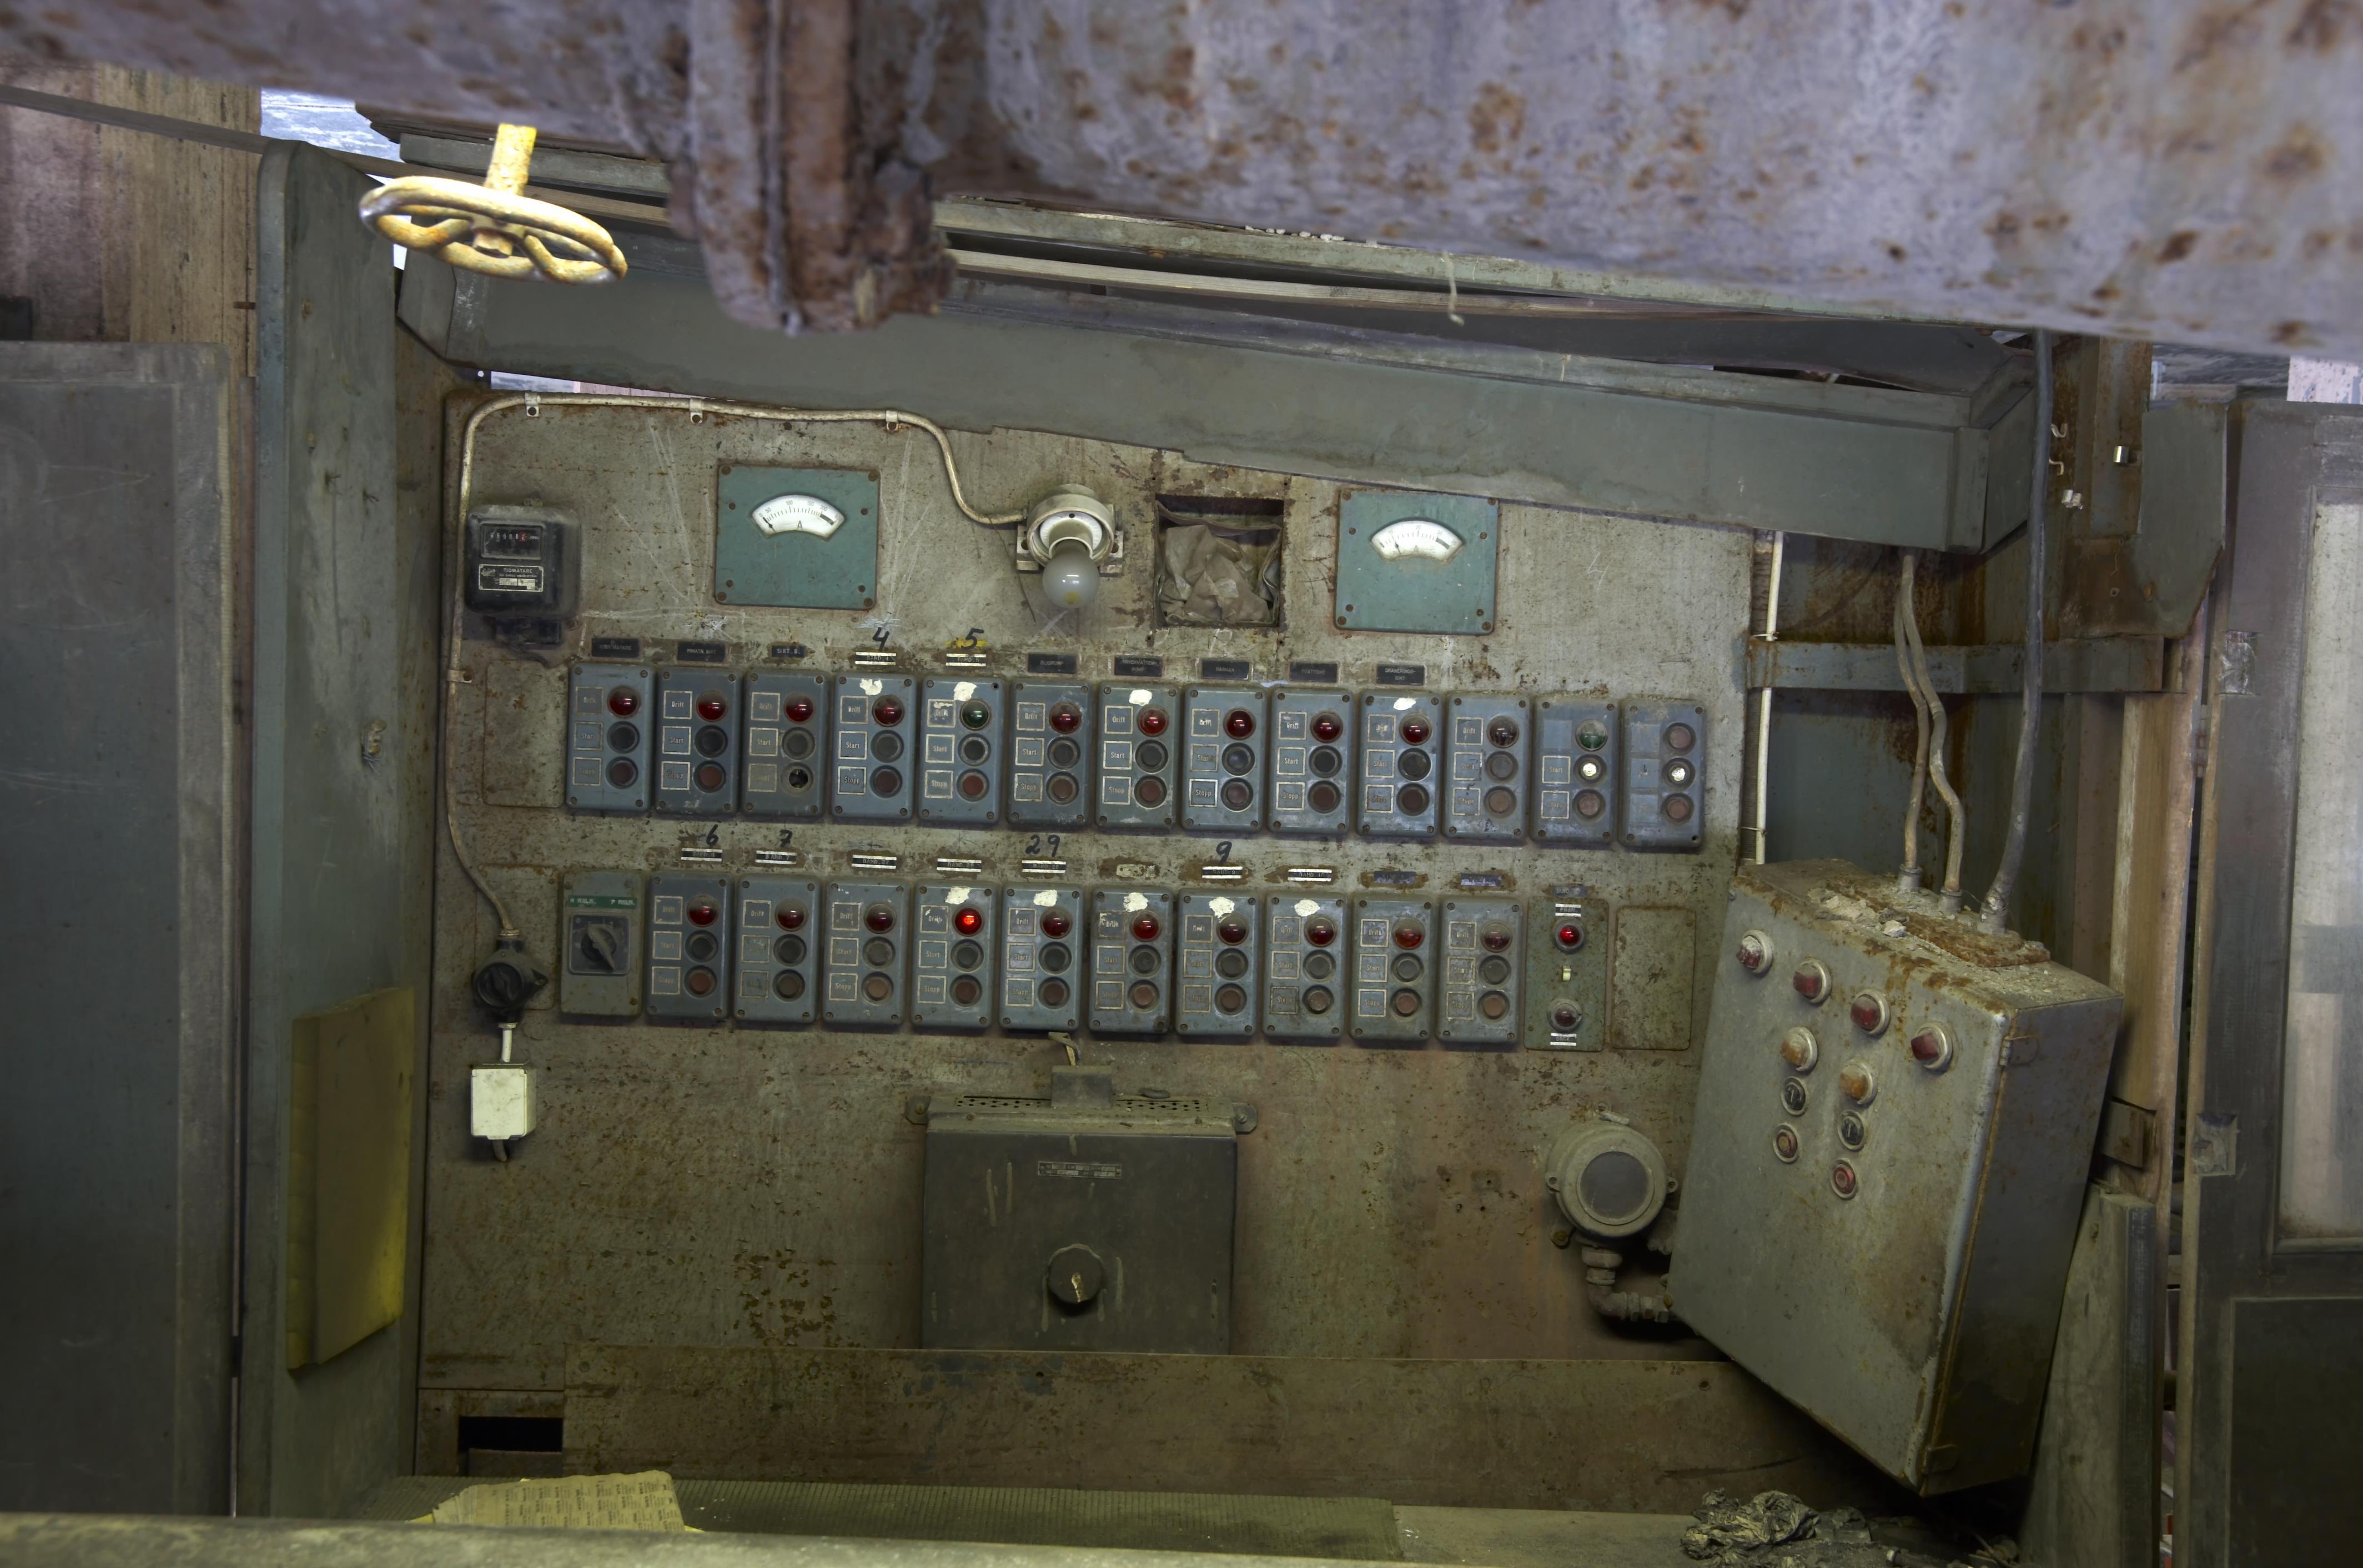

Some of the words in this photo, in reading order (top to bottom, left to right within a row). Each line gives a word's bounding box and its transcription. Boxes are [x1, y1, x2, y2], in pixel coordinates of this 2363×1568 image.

[797, 520, 803, 529] A
[872, 627, 889, 652] 4
[961, 627, 984, 650] 5
[844, 776, 861, 785] Stopp
[1283, 792, 1299, 800] Stopp
[706, 824, 719, 846] 6
[1025, 834, 1060, 857] 29
[1216, 841, 1232, 864] 9
